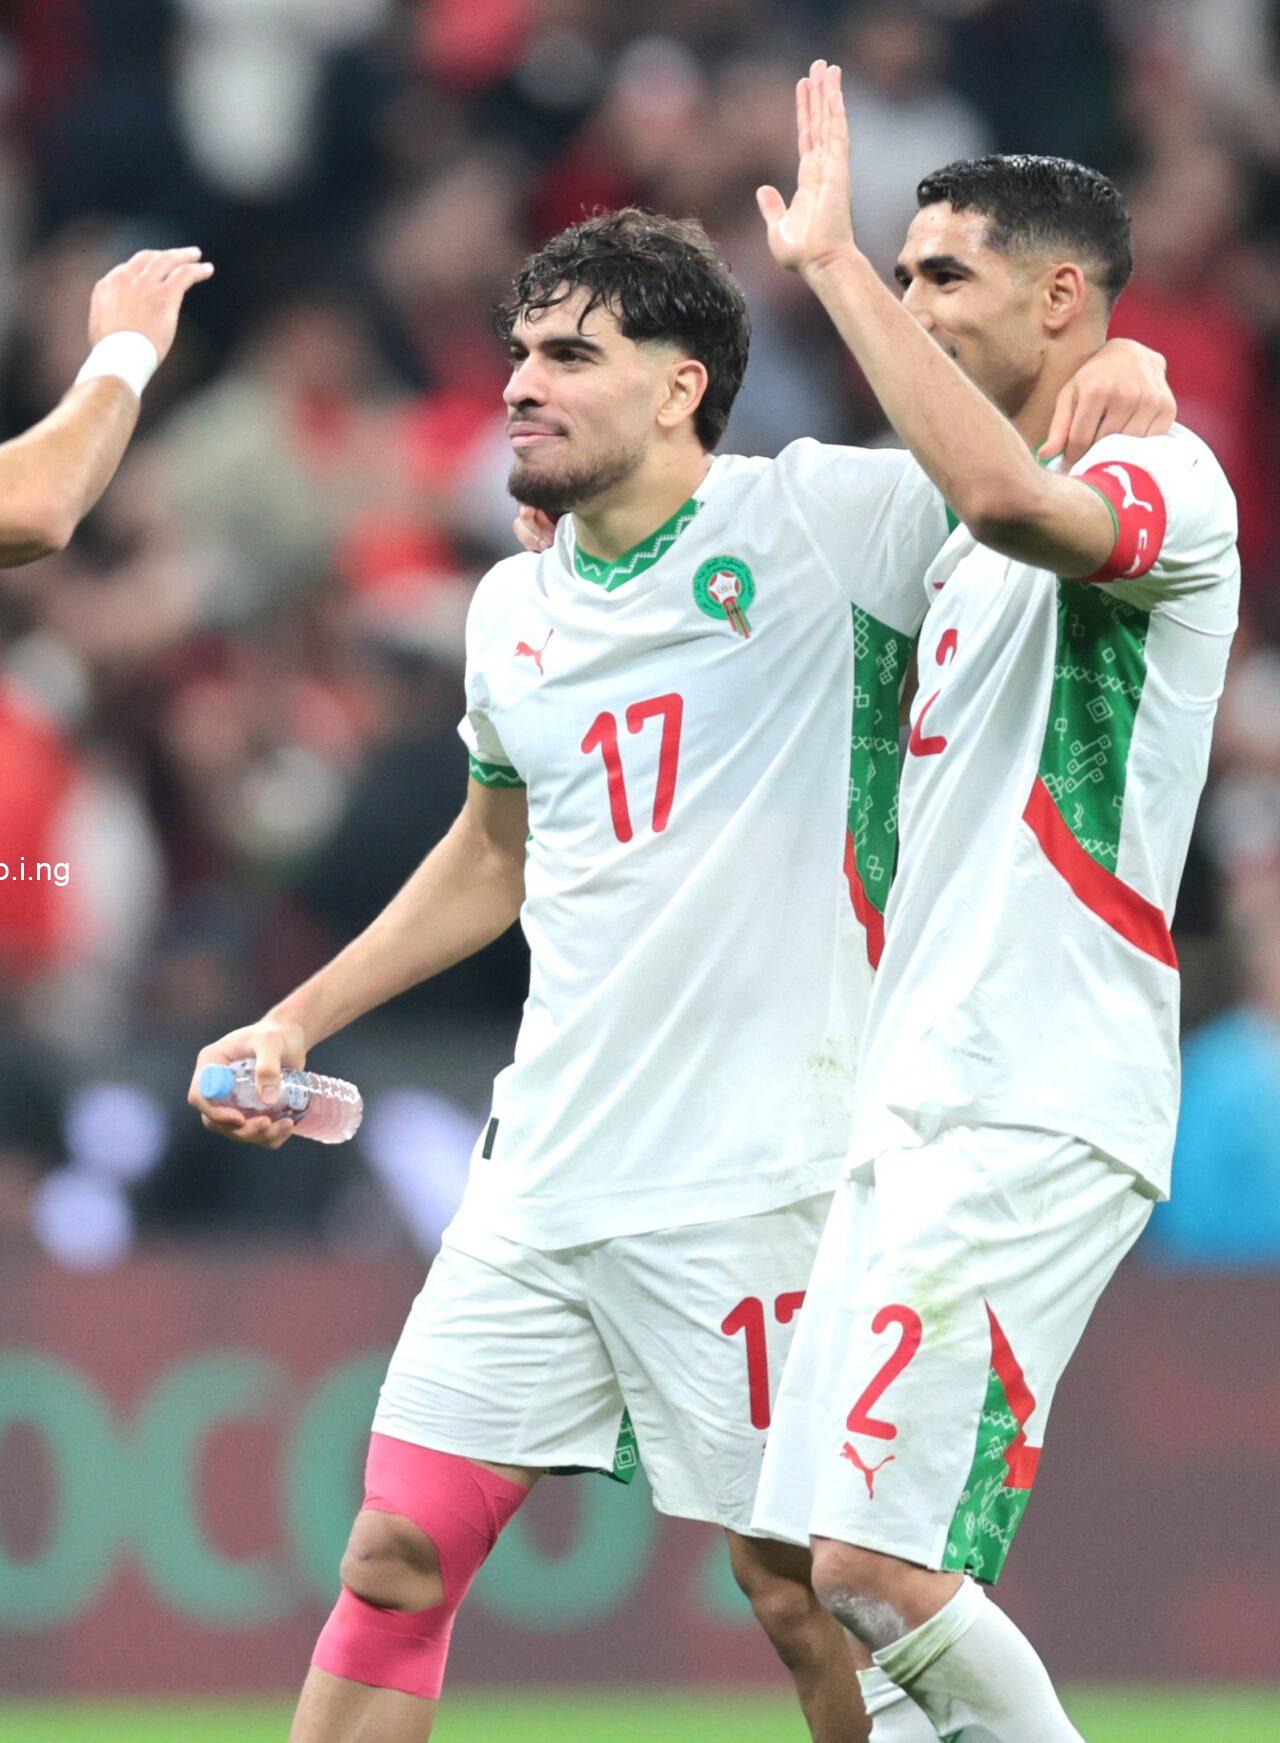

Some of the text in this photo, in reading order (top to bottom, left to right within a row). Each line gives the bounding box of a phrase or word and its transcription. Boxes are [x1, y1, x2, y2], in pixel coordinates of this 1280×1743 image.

[908, 627, 959, 758] 2
[581, 692, 685, 844] 17
[721, 1290, 806, 1431] 1
[845, 1302, 924, 1441] 2
